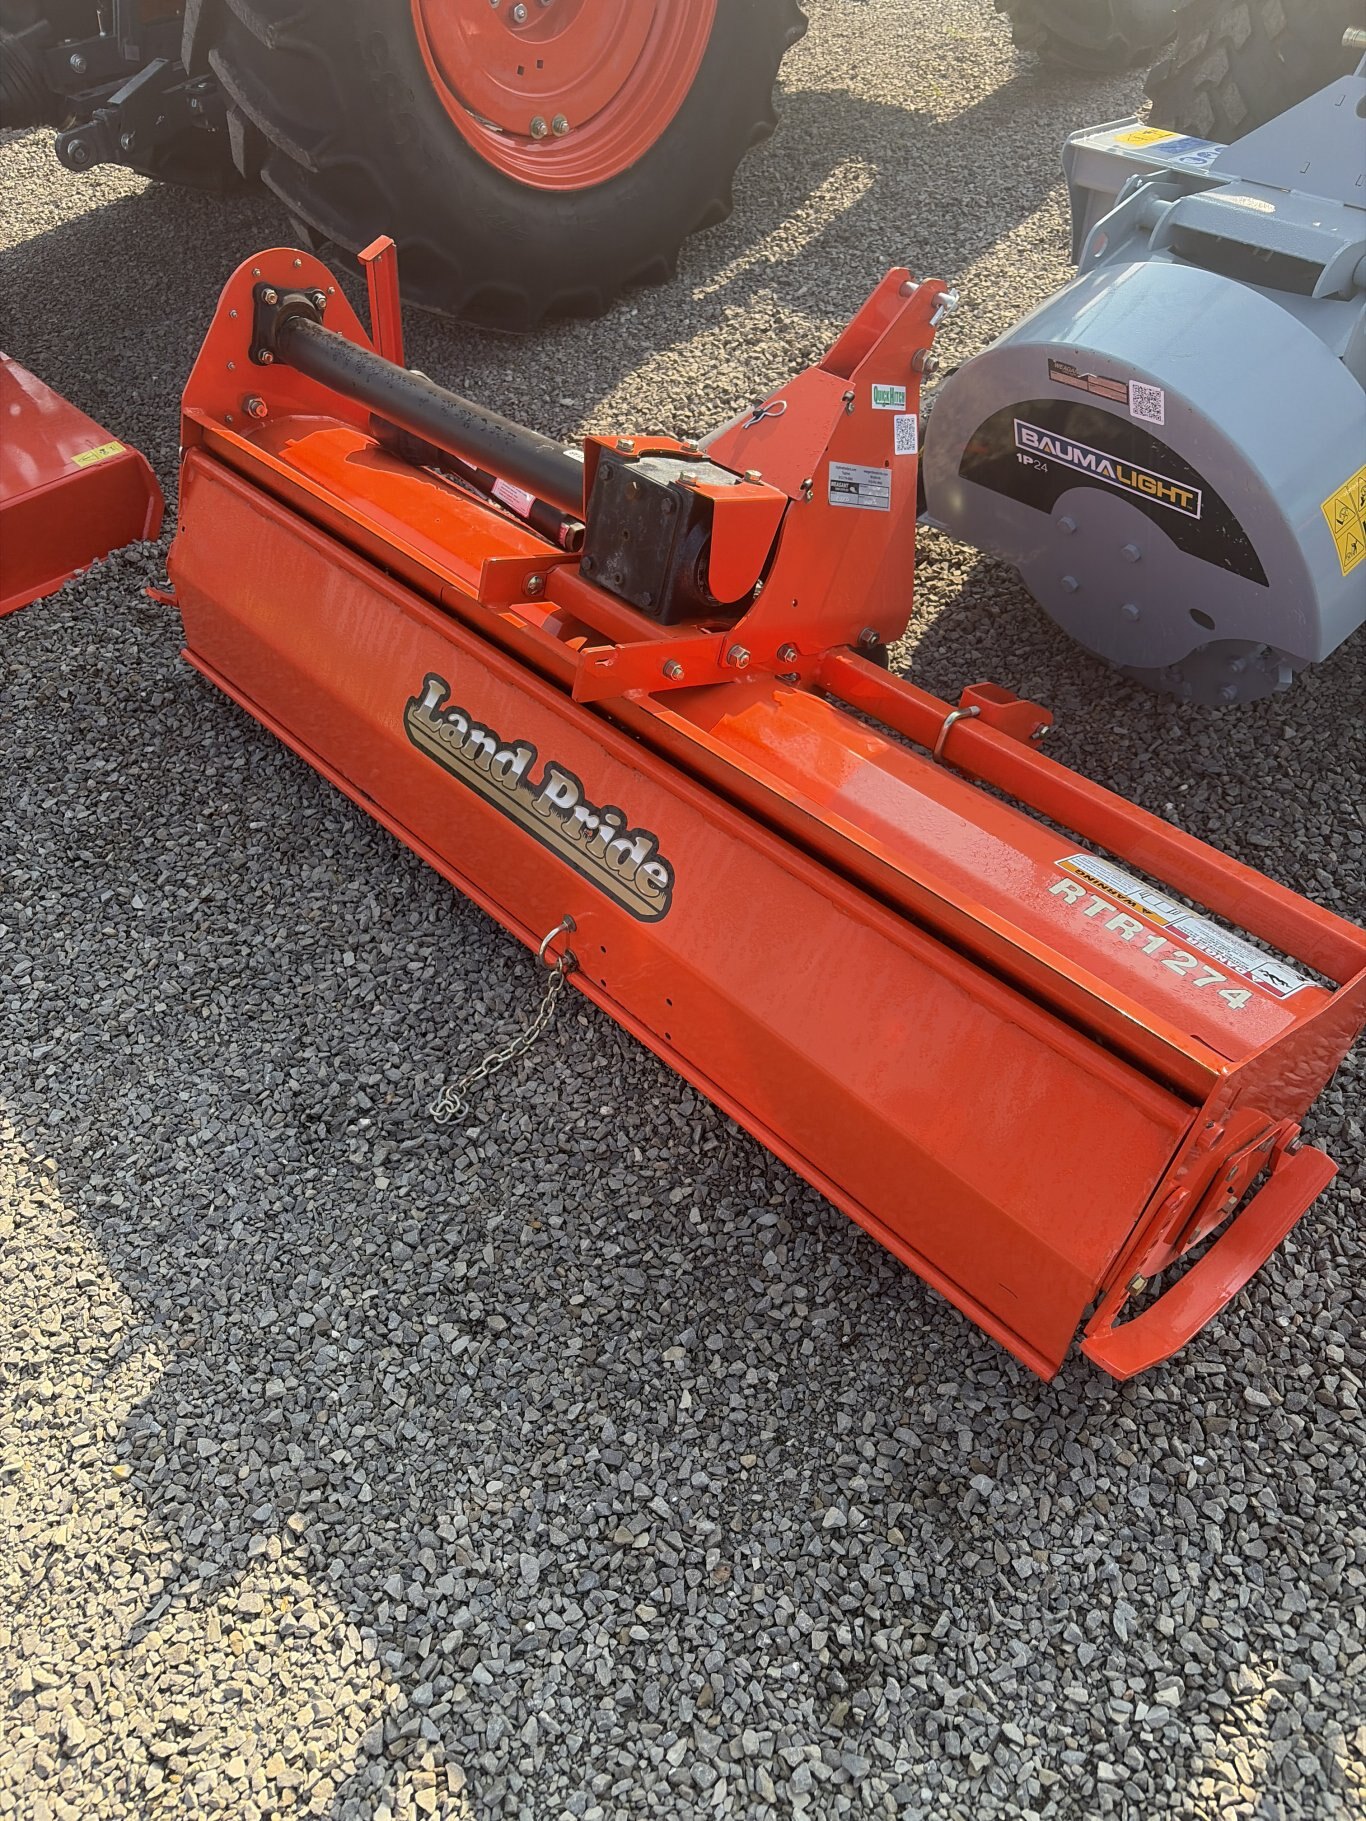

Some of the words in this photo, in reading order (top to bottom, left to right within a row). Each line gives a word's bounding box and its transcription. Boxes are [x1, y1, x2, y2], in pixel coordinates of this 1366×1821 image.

[1016, 452, 1048, 473] 1P24
[1021, 427, 1194, 508] BAUMALIGHT
[413, 679, 532, 791] Land
[532, 768, 669, 898] Pride
[1075, 868, 1137, 908] WARNING
[1047, 876, 1254, 1010] RTR1274
[1186, 936, 1249, 975] DANGER
